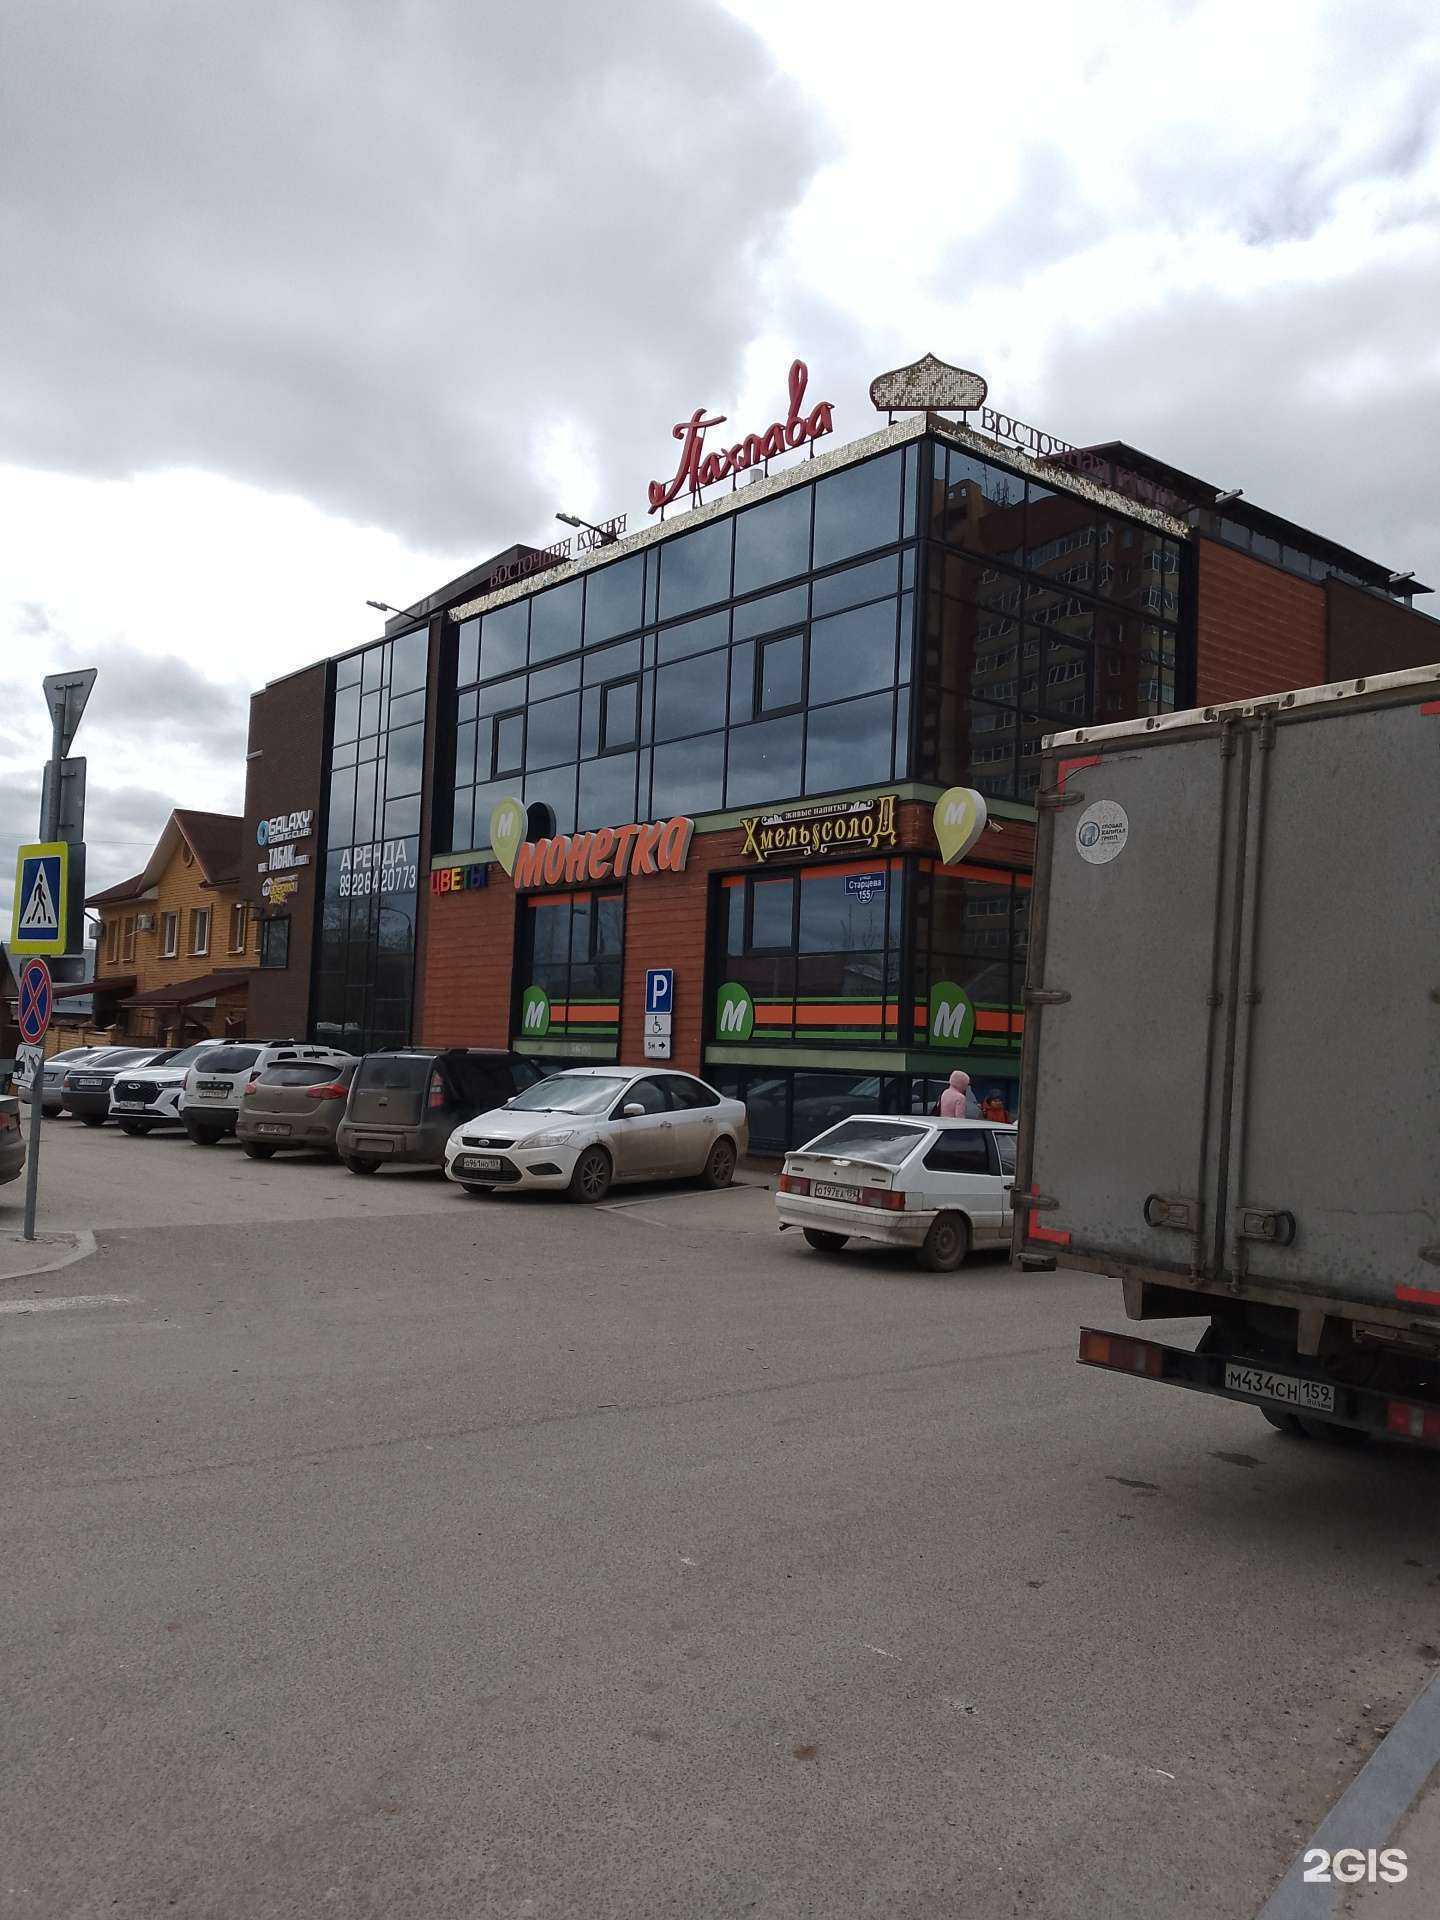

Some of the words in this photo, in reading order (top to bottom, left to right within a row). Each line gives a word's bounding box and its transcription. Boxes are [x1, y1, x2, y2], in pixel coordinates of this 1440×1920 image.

[268, 810, 313, 836] GALAXY
[268, 844, 297, 871] ТАБАК
[340, 839, 407, 872] АРЕНДА
[430, 863, 488, 896] ЦВЕТЫ
[849, 879, 882, 890] Старцева
[859, 889, 871, 900] 155
[1229, 1370, 1297, 1400] М434СН
[1302, 1382, 1330, 1402] 159
